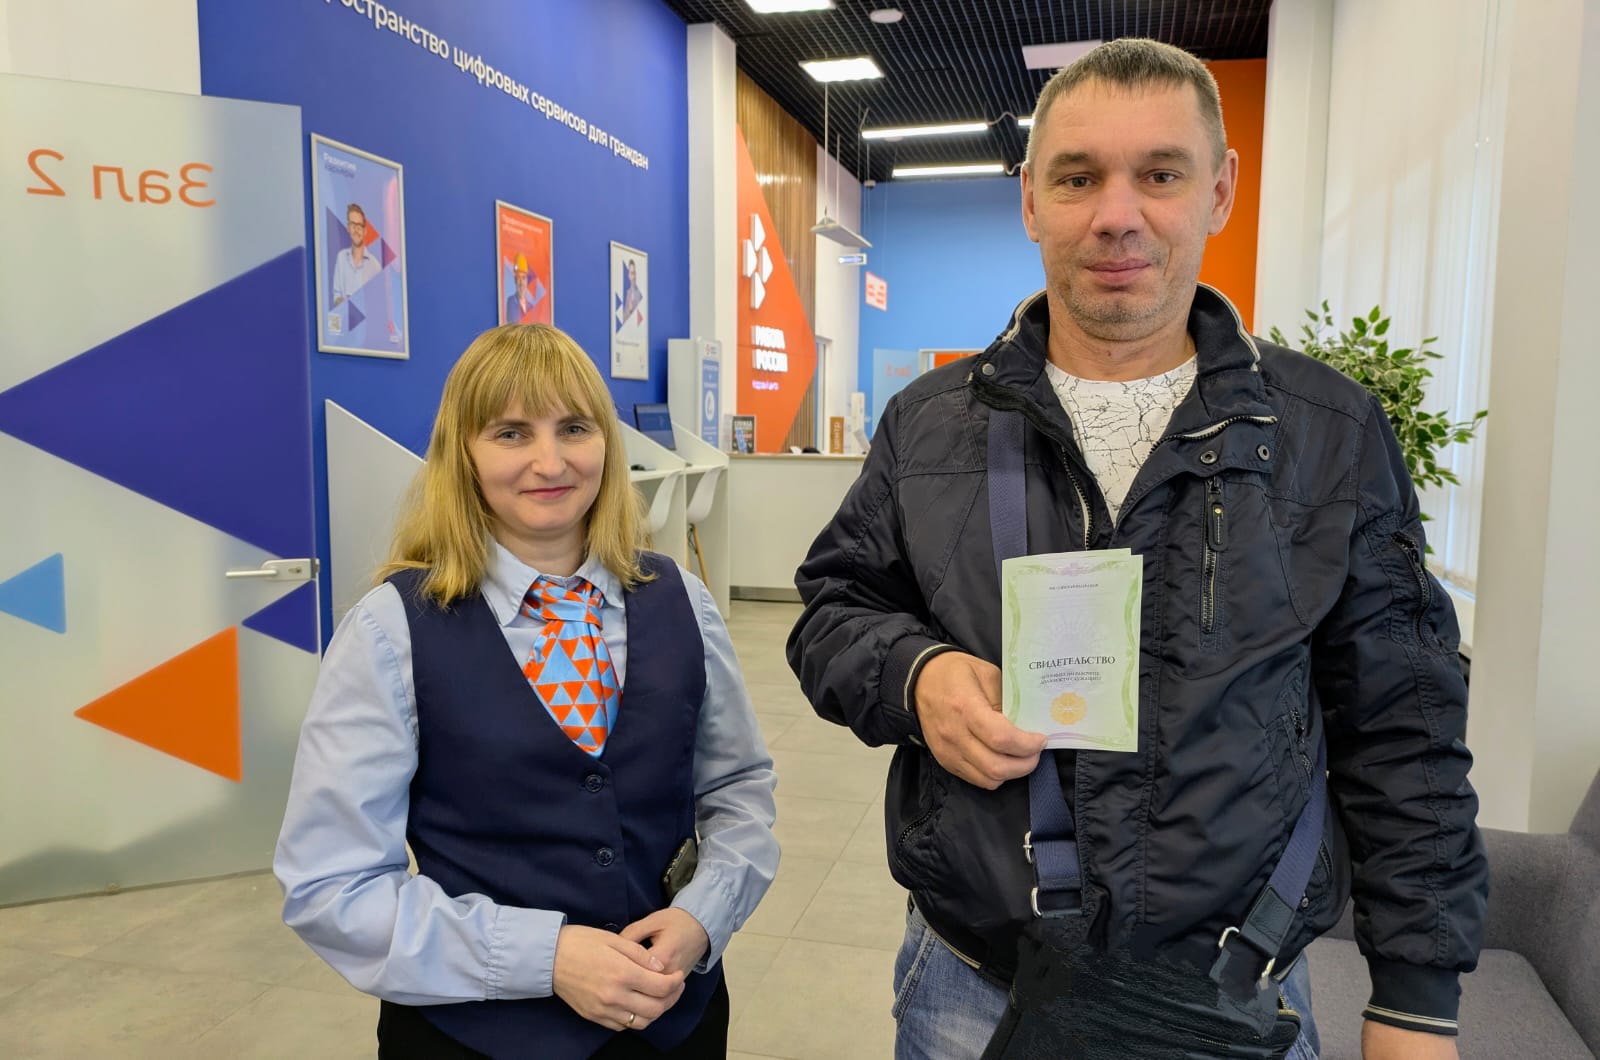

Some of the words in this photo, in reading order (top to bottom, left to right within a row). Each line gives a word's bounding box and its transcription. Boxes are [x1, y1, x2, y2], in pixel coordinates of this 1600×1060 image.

[325, 0, 450, 59] странство
[453, 46, 529, 104] цифровых
[531, 91, 587, 135] сервисов
[588, 124, 608, 147] для
[609, 135, 649, 170] граждан
[1028, 655, 1117, 670] СВИДЕТЕЛЬСТВО
